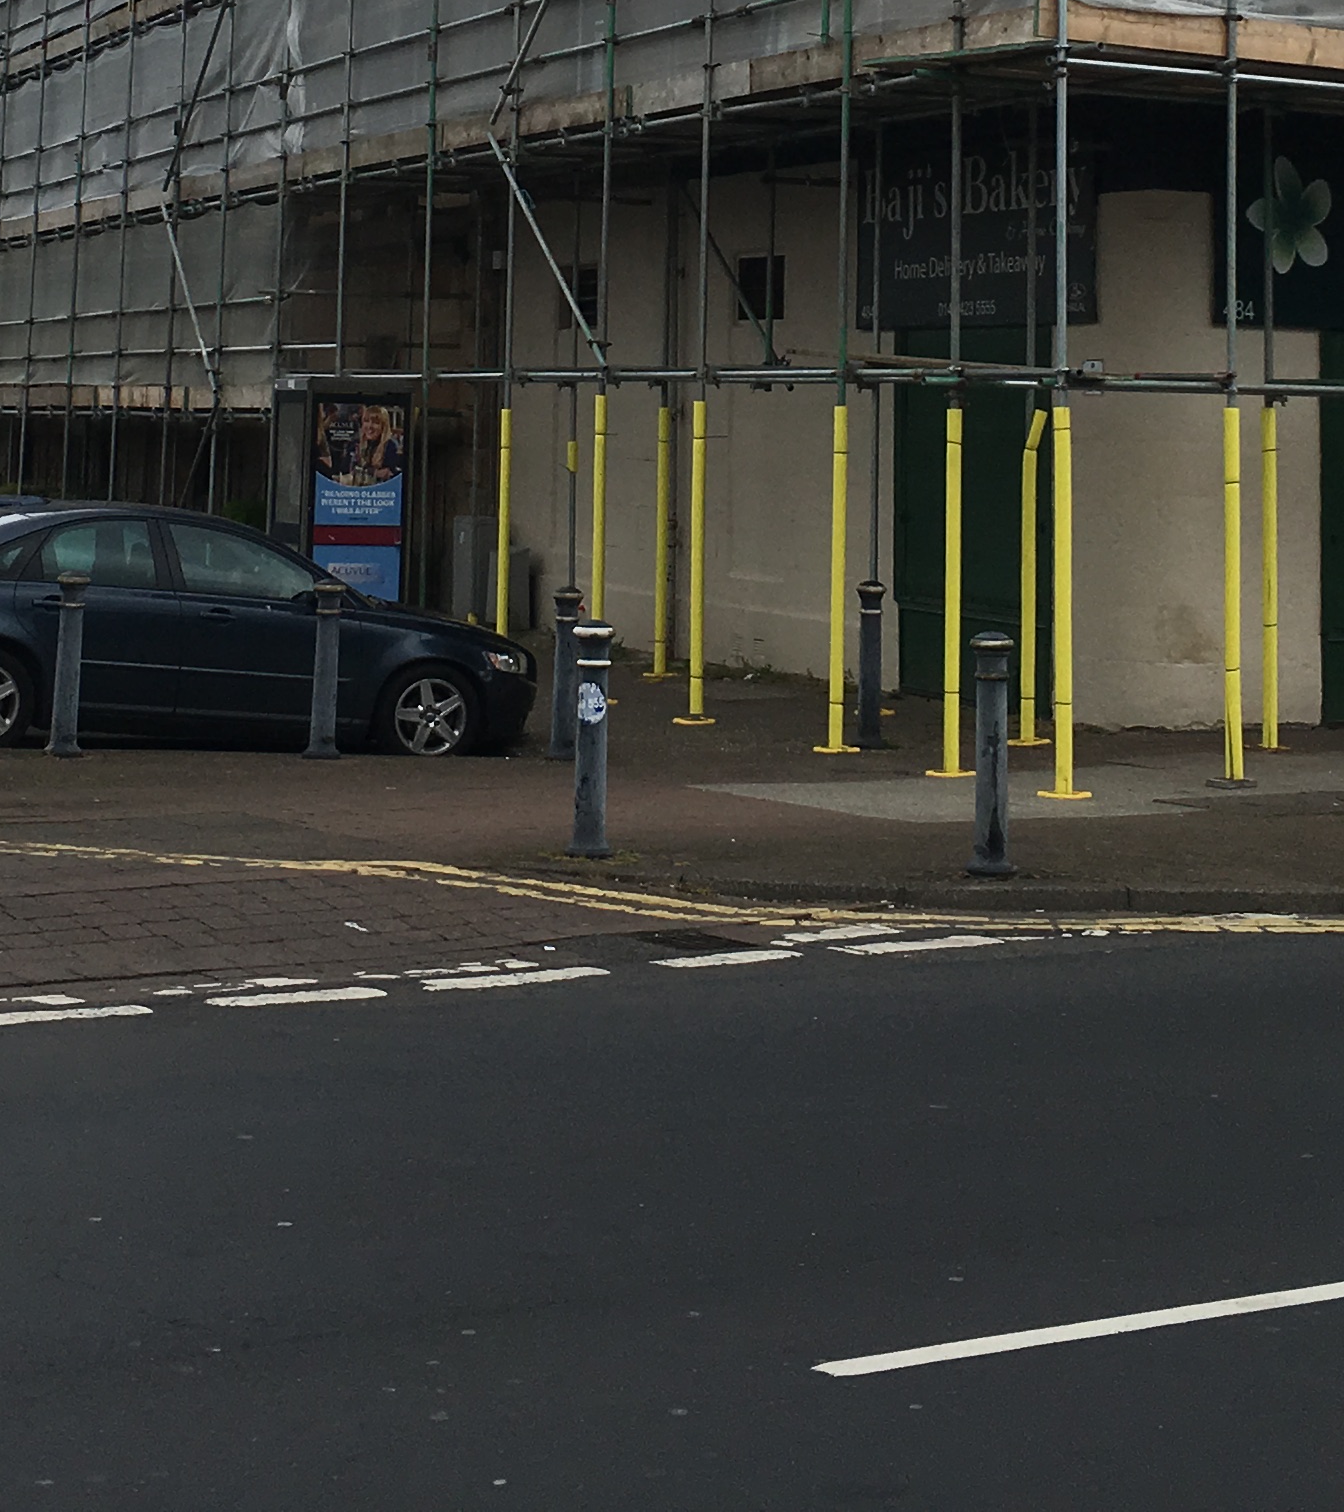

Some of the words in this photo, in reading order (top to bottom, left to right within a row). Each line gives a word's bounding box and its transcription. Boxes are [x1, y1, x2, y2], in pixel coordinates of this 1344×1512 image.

[894, 258, 927, 280] Home
[929, 255, 975, 280] Deliery
[976, 253, 986, 275] &
[1223, 299, 1255, 320] 84
